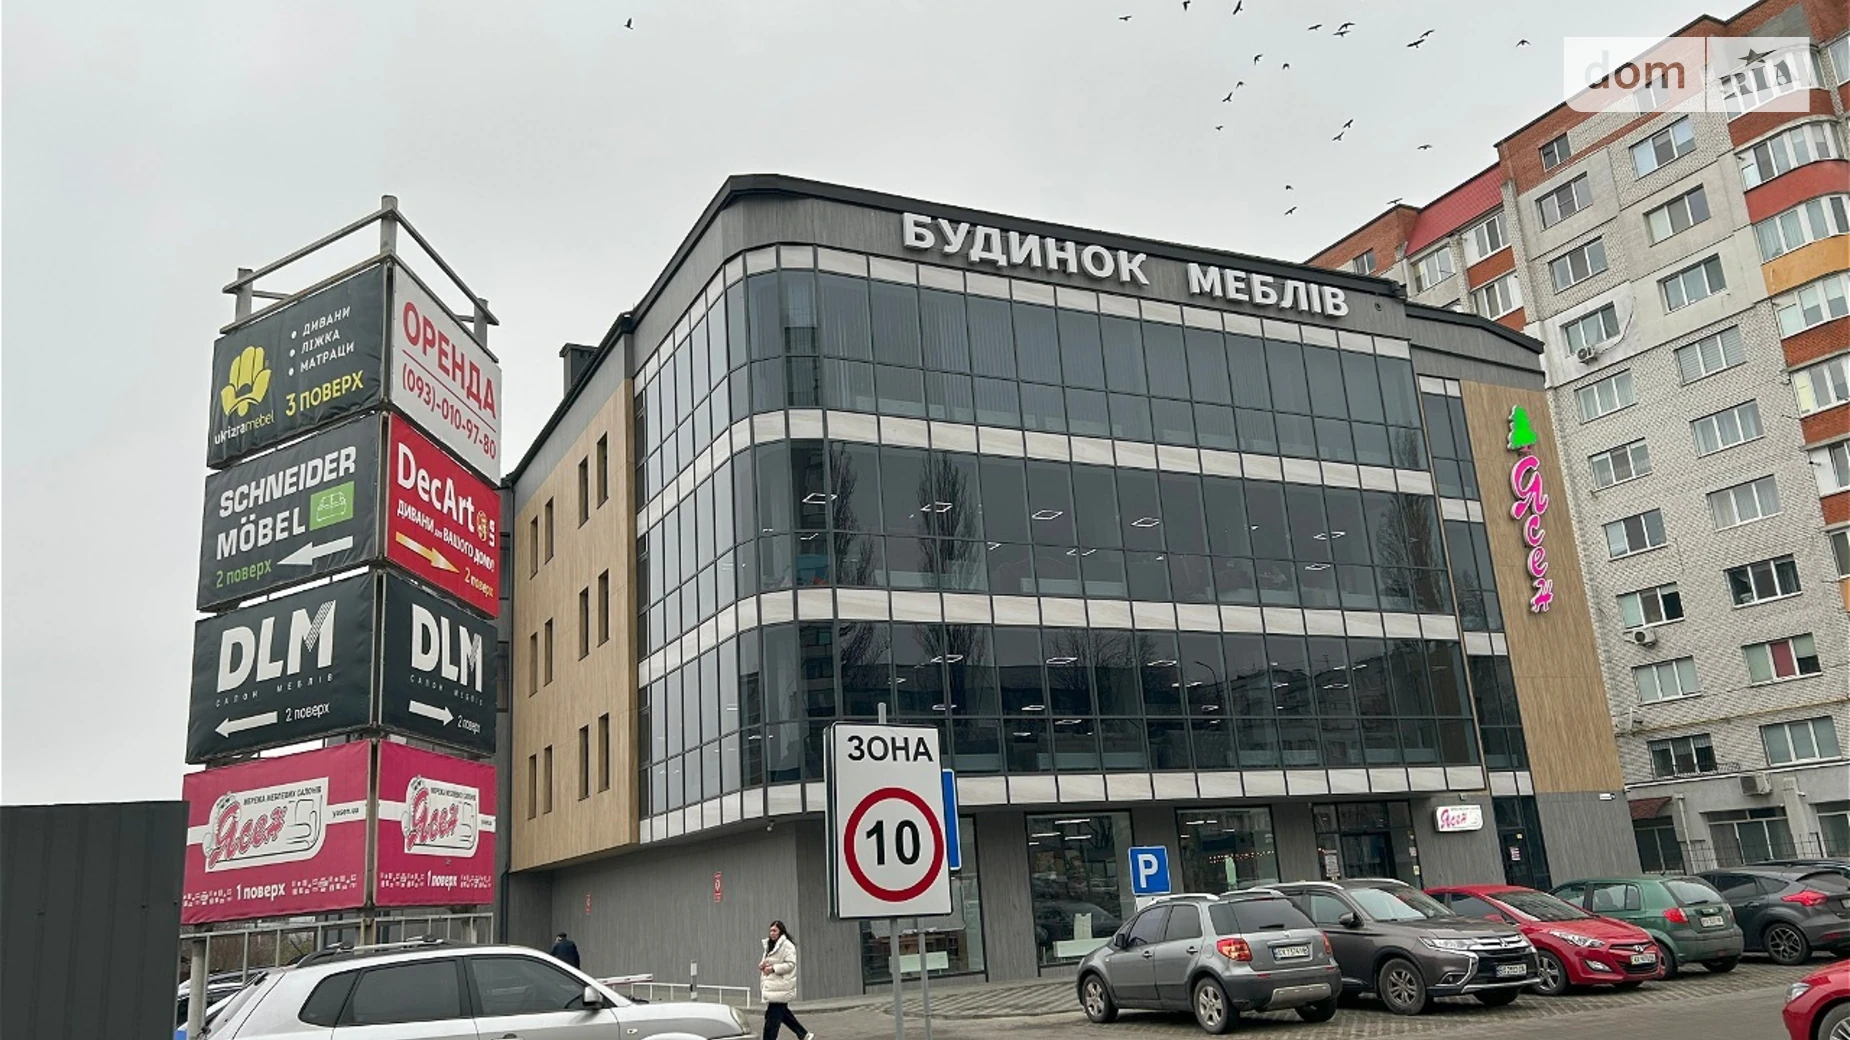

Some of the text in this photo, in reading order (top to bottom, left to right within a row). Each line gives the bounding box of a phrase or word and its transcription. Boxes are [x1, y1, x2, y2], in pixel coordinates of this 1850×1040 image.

[902, 211, 1349, 318] БУДИНОК МЕБЛІВ
[302, 305, 350, 337] ДИВАНИ
[300, 328, 341, 354] ЛІЖКА
[300, 341, 355, 373] МАТРАЦИ
[402, 301, 497, 420] ОРЕНДА
[285, 369, 364, 417] 3 ПОВЕРХ
[214, 409, 275, 445] ukrizramebel
[402, 362, 497, 460] (093)-010-97-80
[218, 446, 357, 518] SCHNEIDER
[215, 506, 306, 560] MÖBEL
[396, 498, 434, 533] ДИВАНИ
[216, 558, 273, 588] 2 поверх
[464, 567, 471, 583] 2
[216, 599, 337, 693] DLM
[411, 602, 483, 693] DLM
[215, 673, 333, 708] САЛОН МЕБЛІВ
[285, 702, 330, 722] 2 поверх
[457, 714, 463, 728] 2
[847, 735, 934, 762] ЗОНА
[865, 819, 921, 866] 10
[427, 872, 458, 889] 1 поверх
[1137, 853, 1159, 888] P
[236, 882, 286, 899] 1 поверх
